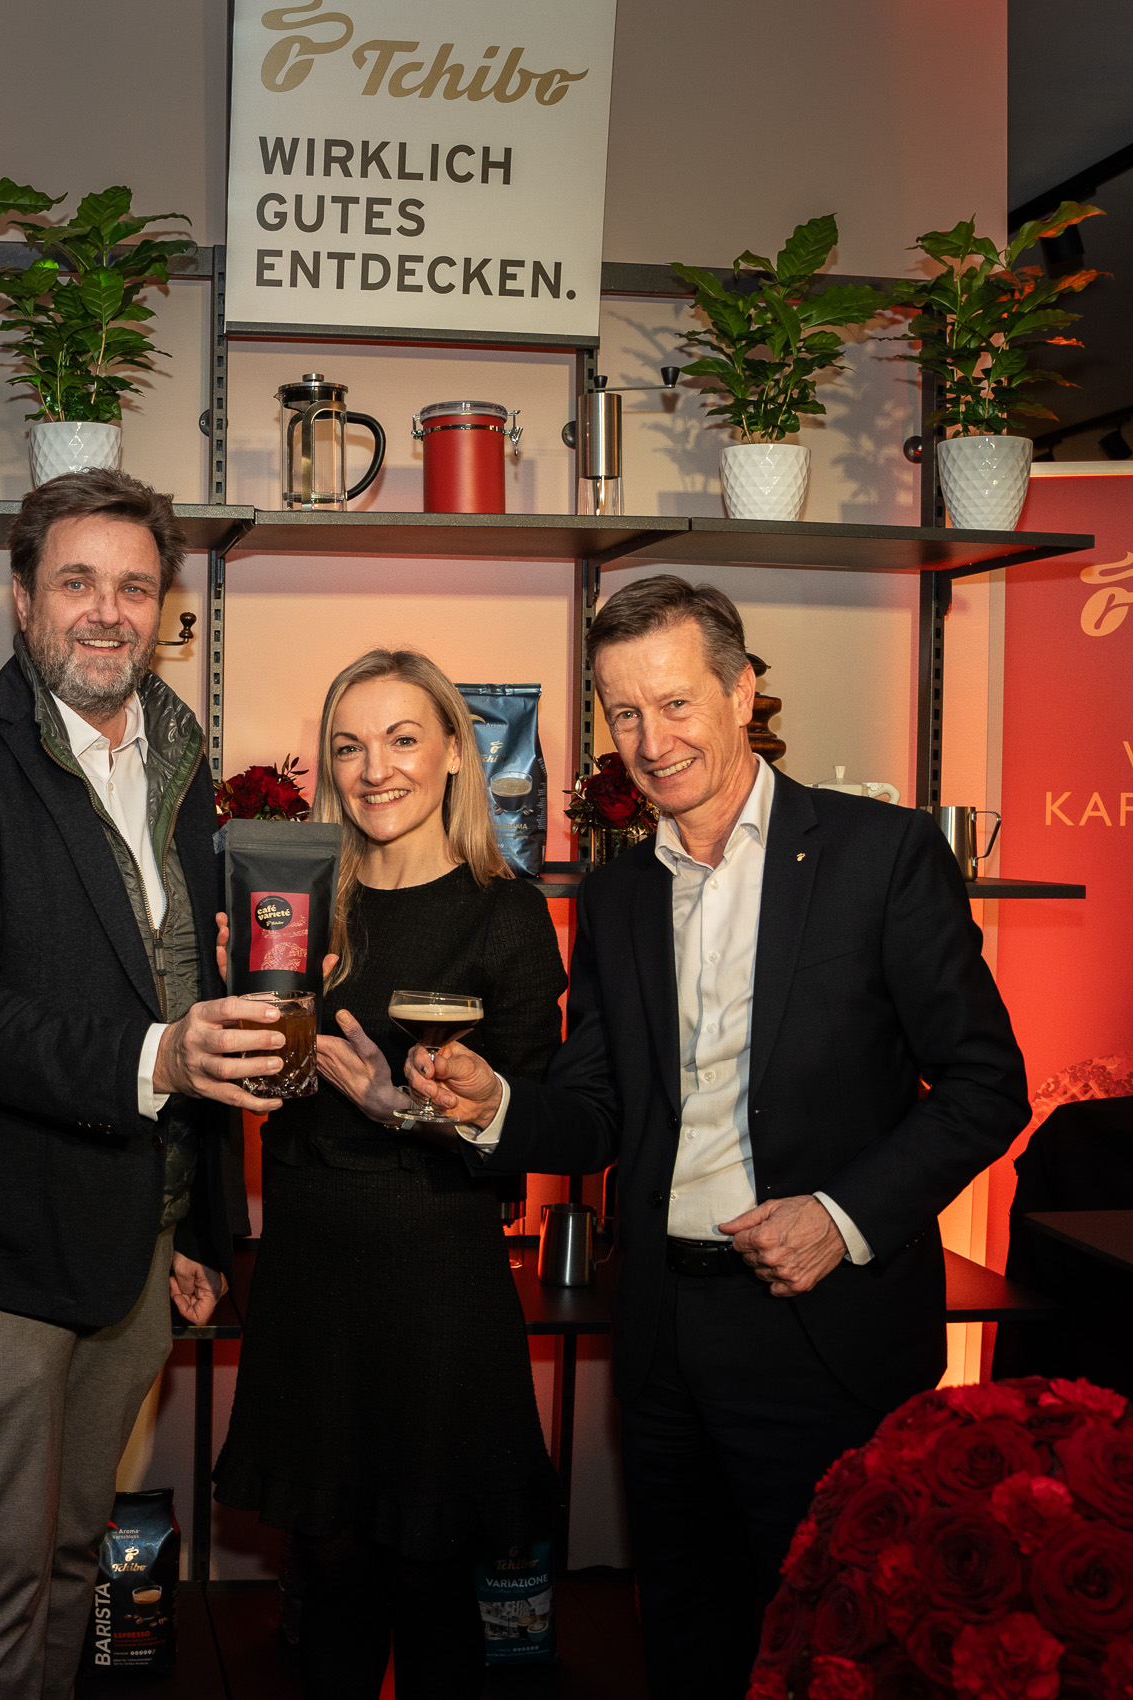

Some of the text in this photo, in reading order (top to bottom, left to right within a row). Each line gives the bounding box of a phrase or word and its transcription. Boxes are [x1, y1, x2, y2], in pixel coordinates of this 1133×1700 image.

[351, 39, 589, 106] Tchibo
[258, 136, 512, 185] WIRKLICH
[256, 192, 425, 237] GUTES
[256, 248, 576, 301] ENTDECKEN.
[257, 904, 276, 914] café
[112, 1562, 148, 1573] Tchibo
[485, 1574, 548, 1588] VARIAZIONE
[95, 1582, 111, 1665] BARISTA
[113, 1631, 151, 1639] ESPRESSO
